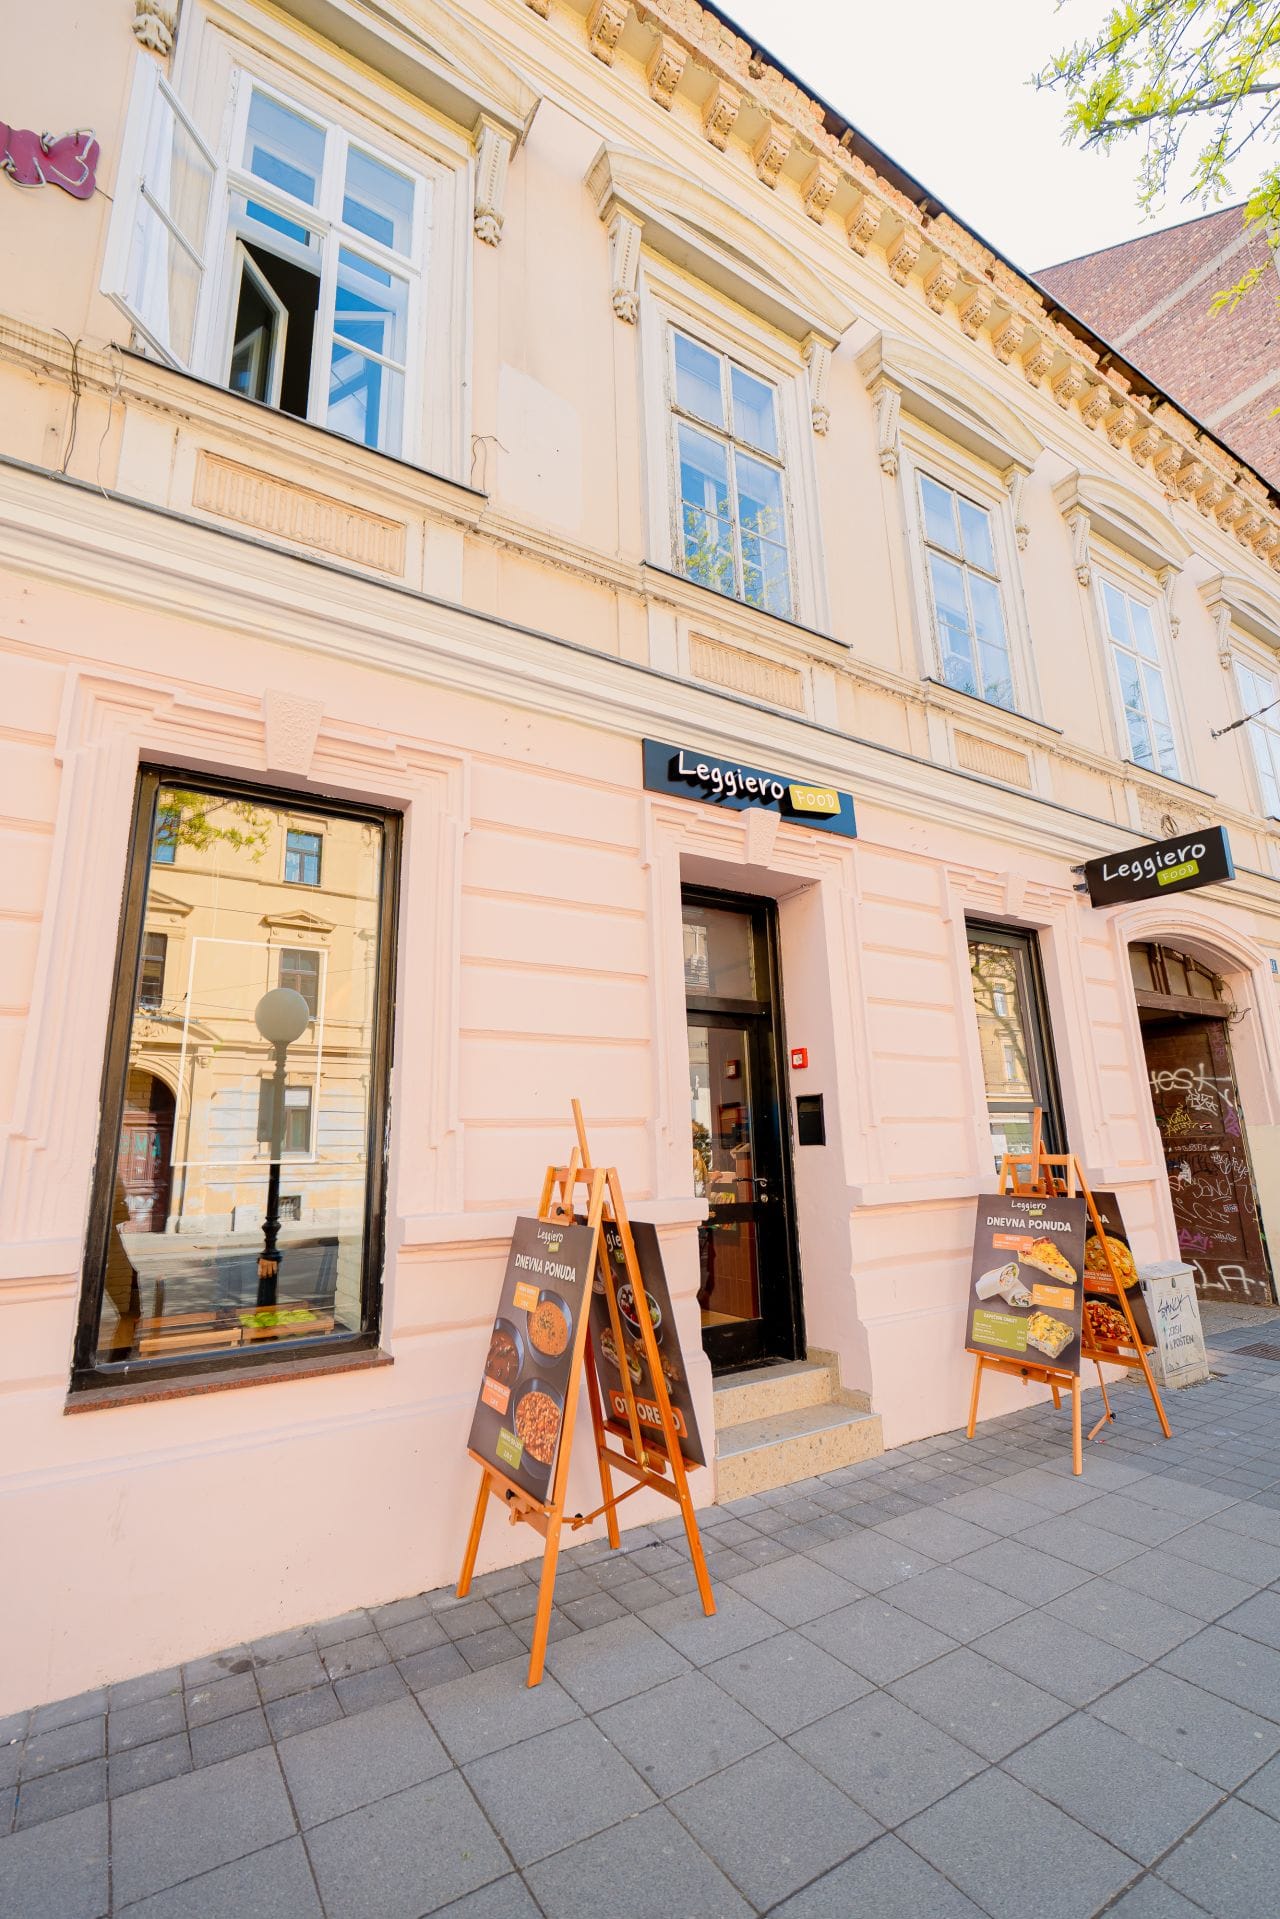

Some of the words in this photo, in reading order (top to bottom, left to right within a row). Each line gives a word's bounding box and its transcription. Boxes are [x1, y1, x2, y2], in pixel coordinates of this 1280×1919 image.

[678, 750, 785, 800] Leggiero
[794, 789, 836, 809] FOOD
[1103, 843, 1206, 882] Leggiero
[1161, 864, 1194, 881] FOOD
[1011, 1200, 1047, 1212] Leggiero
[986, 1216, 1026, 1229] DNEVNA
[1028, 1220, 1072, 1233] PONUDA
[537, 1228, 564, 1245] Leggiero
[514, 1253, 543, 1274] DNEVNA
[543, 1260, 576, 1283] PONUDA
[614, 1396, 681, 1431] OTOREO
